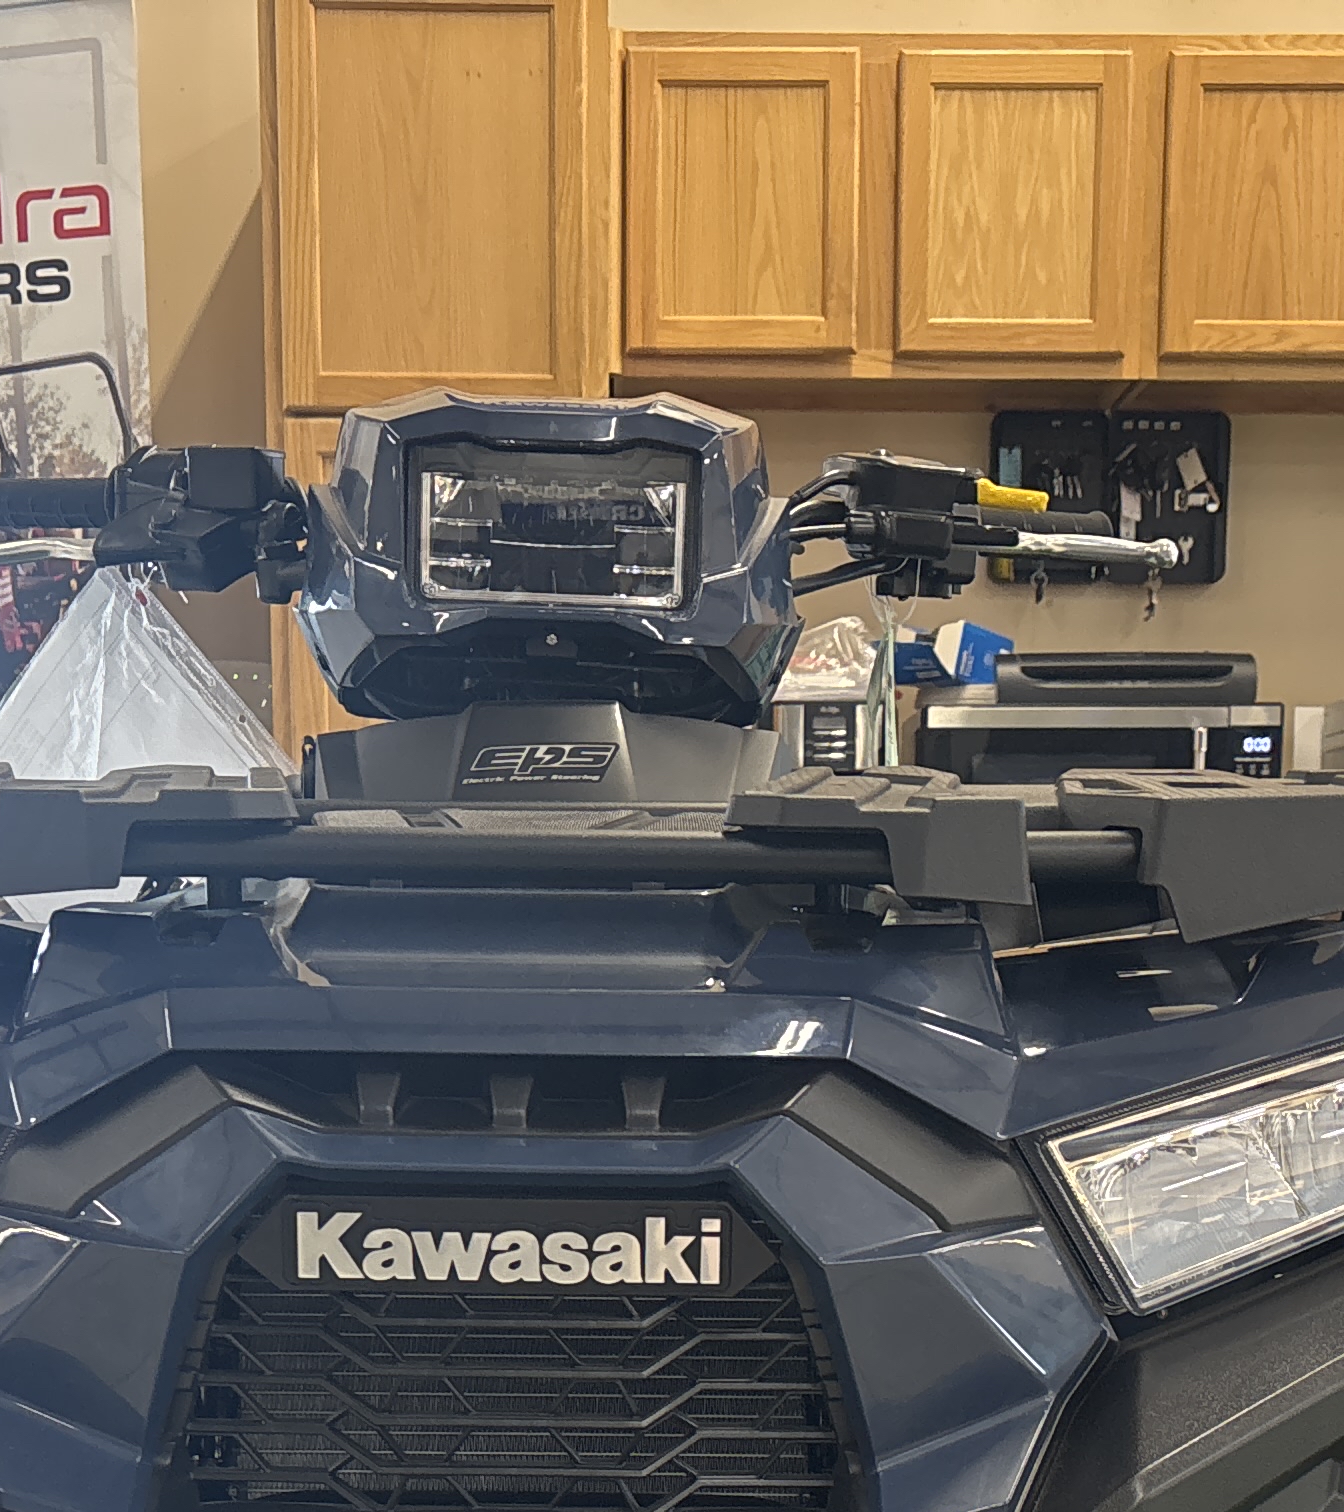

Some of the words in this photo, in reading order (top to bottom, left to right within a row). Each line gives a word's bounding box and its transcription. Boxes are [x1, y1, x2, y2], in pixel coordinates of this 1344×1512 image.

[470, 744, 617, 775] EPS
[462, 776, 505, 785] Electric
[550, 774, 601, 782] Steering
[296, 1211, 722, 1285] Kawasaki
